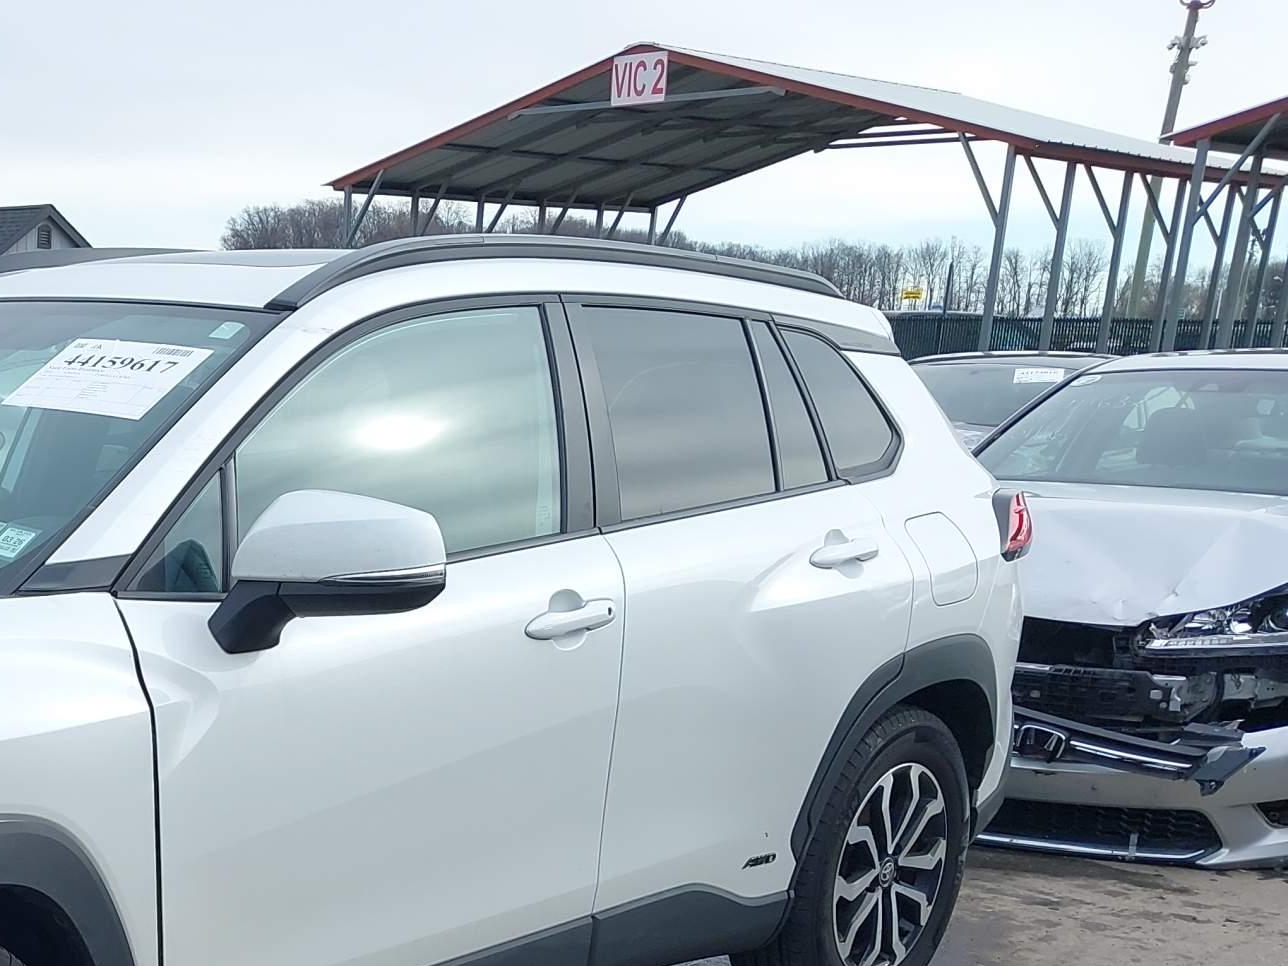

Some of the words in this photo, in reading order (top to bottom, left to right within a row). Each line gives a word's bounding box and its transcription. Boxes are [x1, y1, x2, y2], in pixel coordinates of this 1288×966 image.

[614, 59, 648, 98] VIC
[651, 58, 665, 95] 2
[64, 353, 179, 374] 44159617
